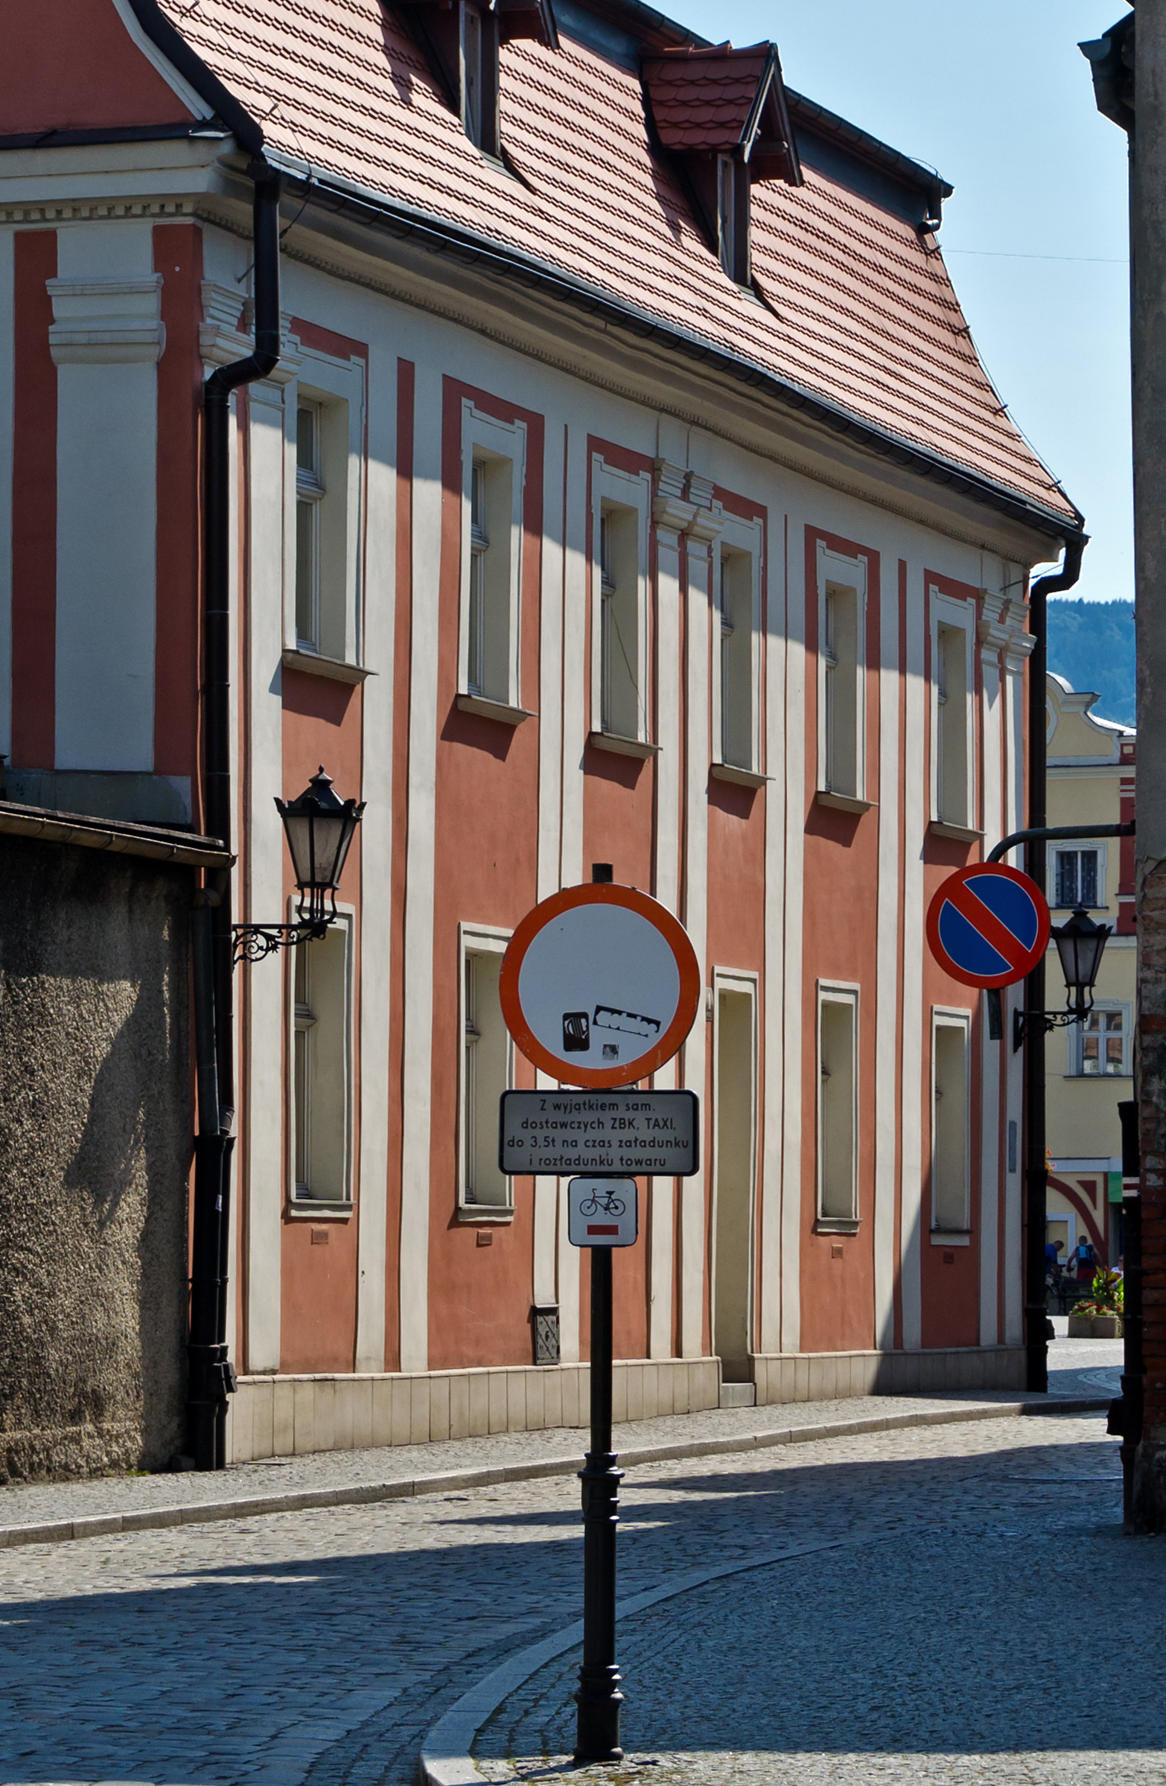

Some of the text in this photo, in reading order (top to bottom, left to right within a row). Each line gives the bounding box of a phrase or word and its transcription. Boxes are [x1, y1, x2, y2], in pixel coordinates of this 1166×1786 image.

[540, 1098, 656, 1114] Z wyjątkiem sam.
[521, 1117, 677, 1133] dostawczych ZBK, TAXI,
[507, 1136, 689, 1150] do 3,5t na czas załadunku
[529, 1154, 666, 1167] i rozładunku towaru
